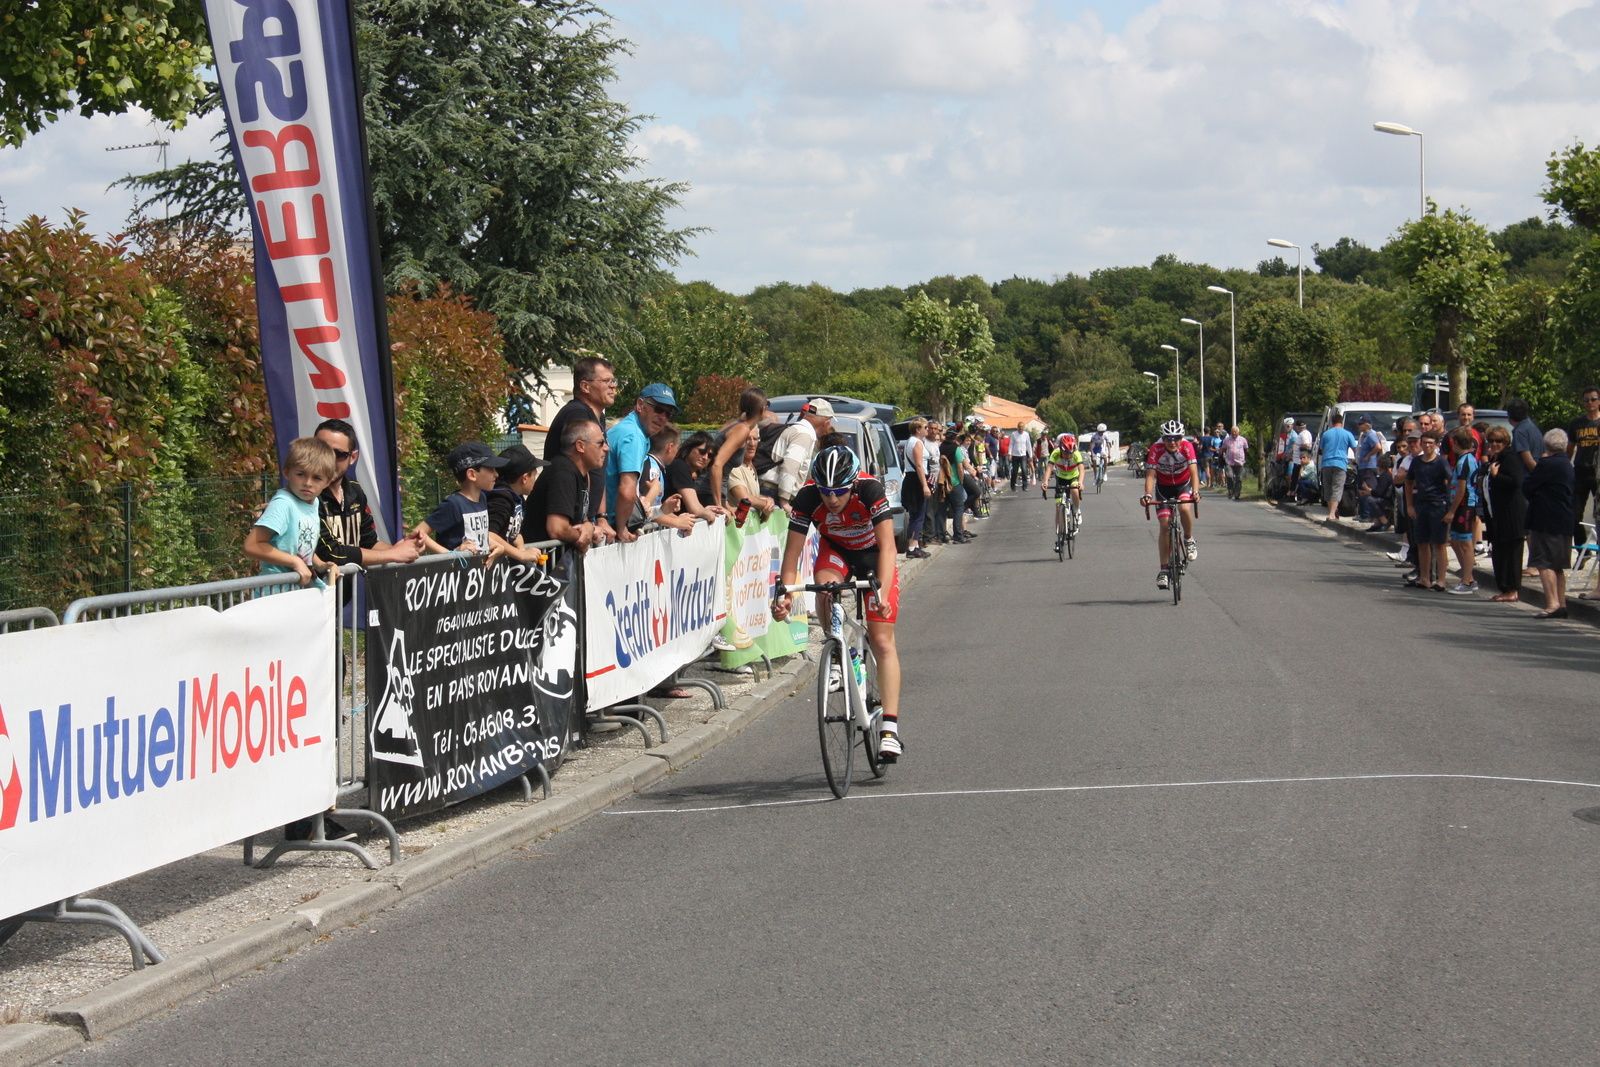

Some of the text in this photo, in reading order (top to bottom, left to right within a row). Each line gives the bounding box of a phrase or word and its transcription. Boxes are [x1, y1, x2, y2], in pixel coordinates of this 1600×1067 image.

[405, 571, 460, 612] ROYAN
[465, 568, 487, 601] BY
[483, 607, 499, 623] SUR
[605, 565, 717, 668] Crédit Mutuel
[410, 650, 423, 676] LE
[426, 633, 495, 672] SPECIALISTE
[427, 683, 443, 710] EN
[448, 674, 475, 704] PAYS
[433, 728, 452, 756] Tél
